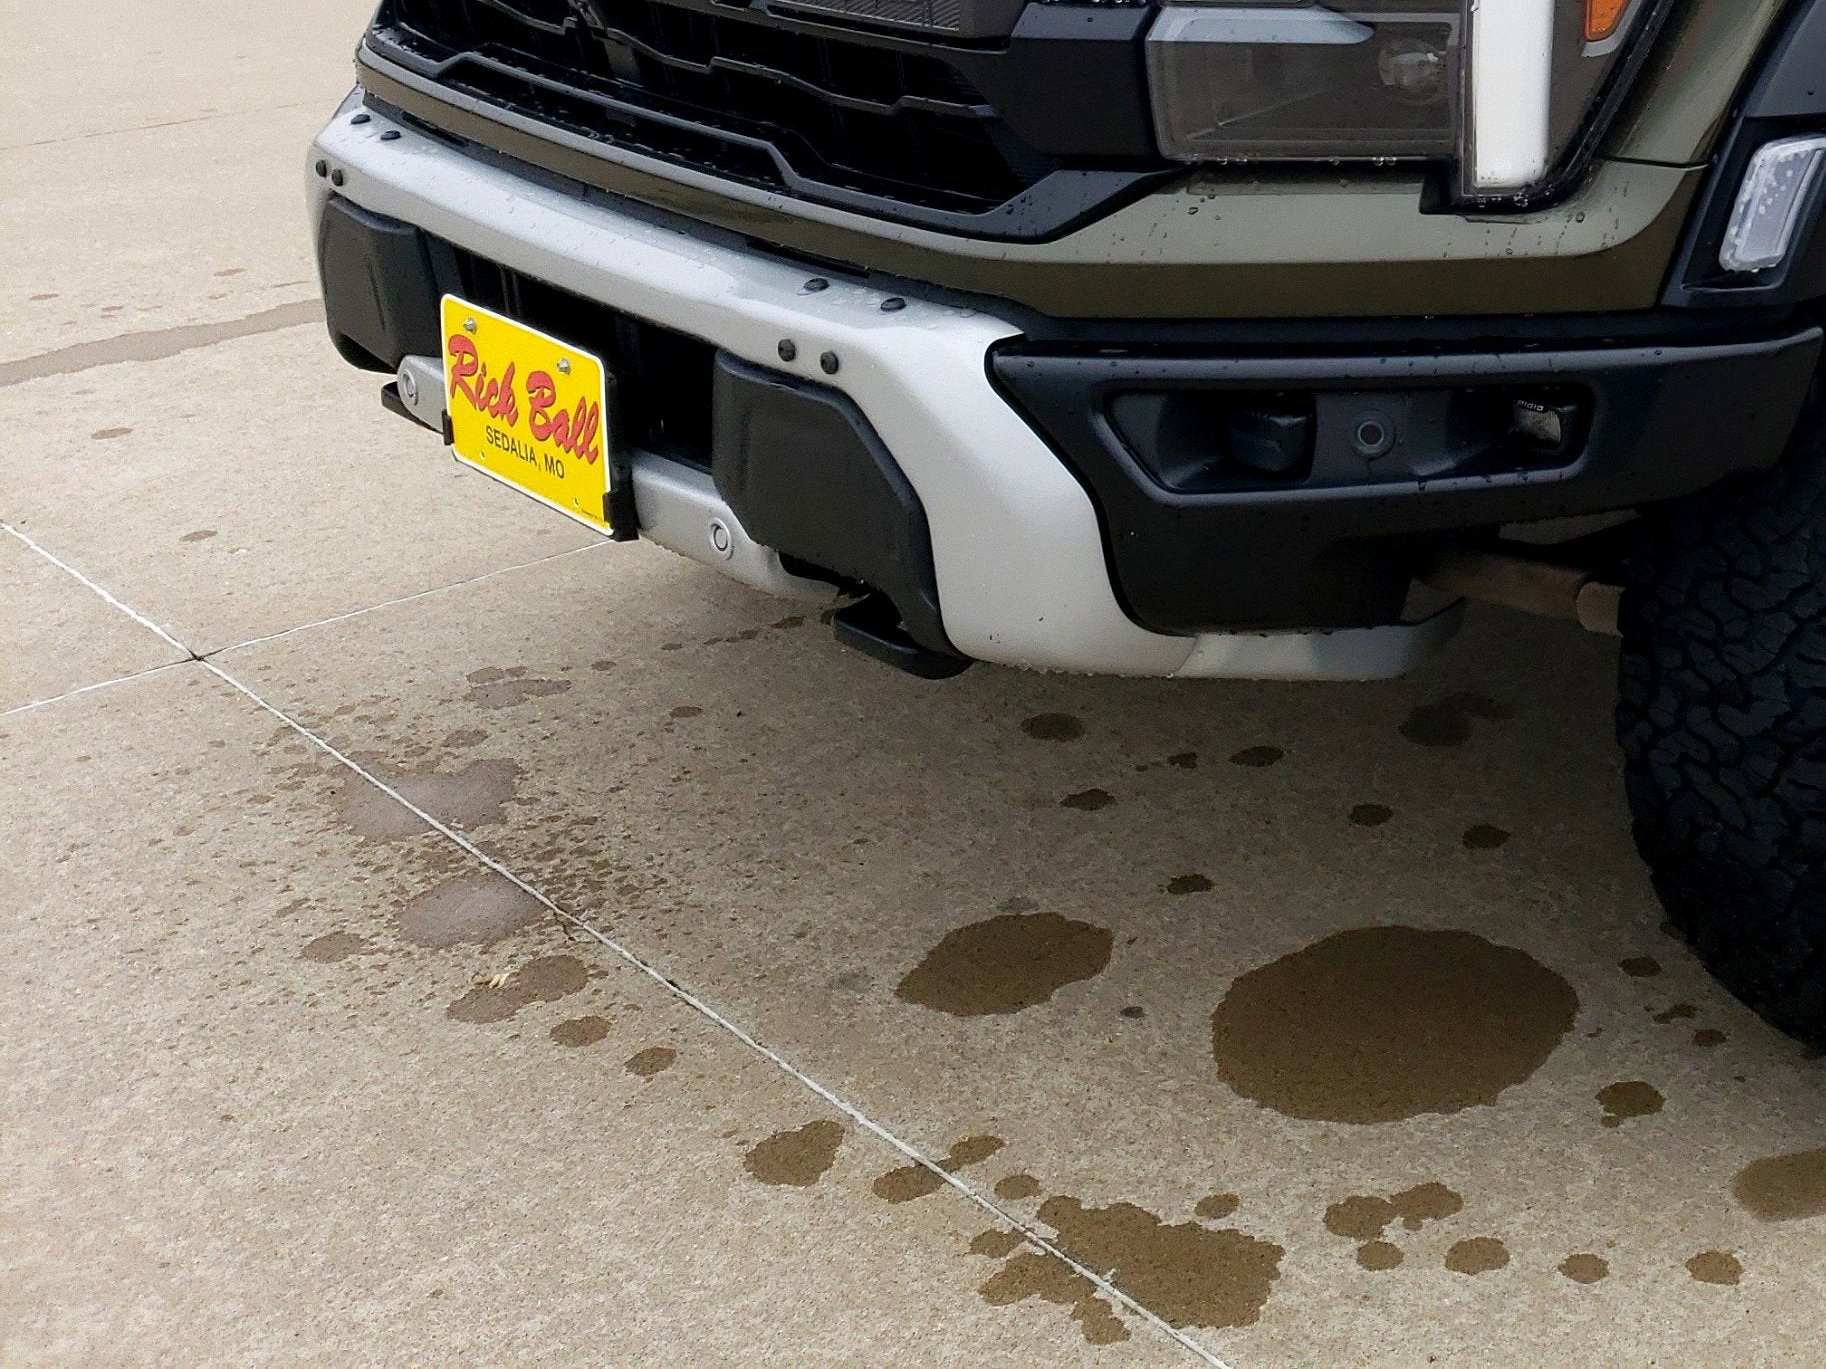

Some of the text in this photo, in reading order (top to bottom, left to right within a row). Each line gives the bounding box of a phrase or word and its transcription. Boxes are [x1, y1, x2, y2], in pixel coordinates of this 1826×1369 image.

[447, 333, 600, 466] Rick Ball
[485, 425, 566, 480] SEDALIA, MO
